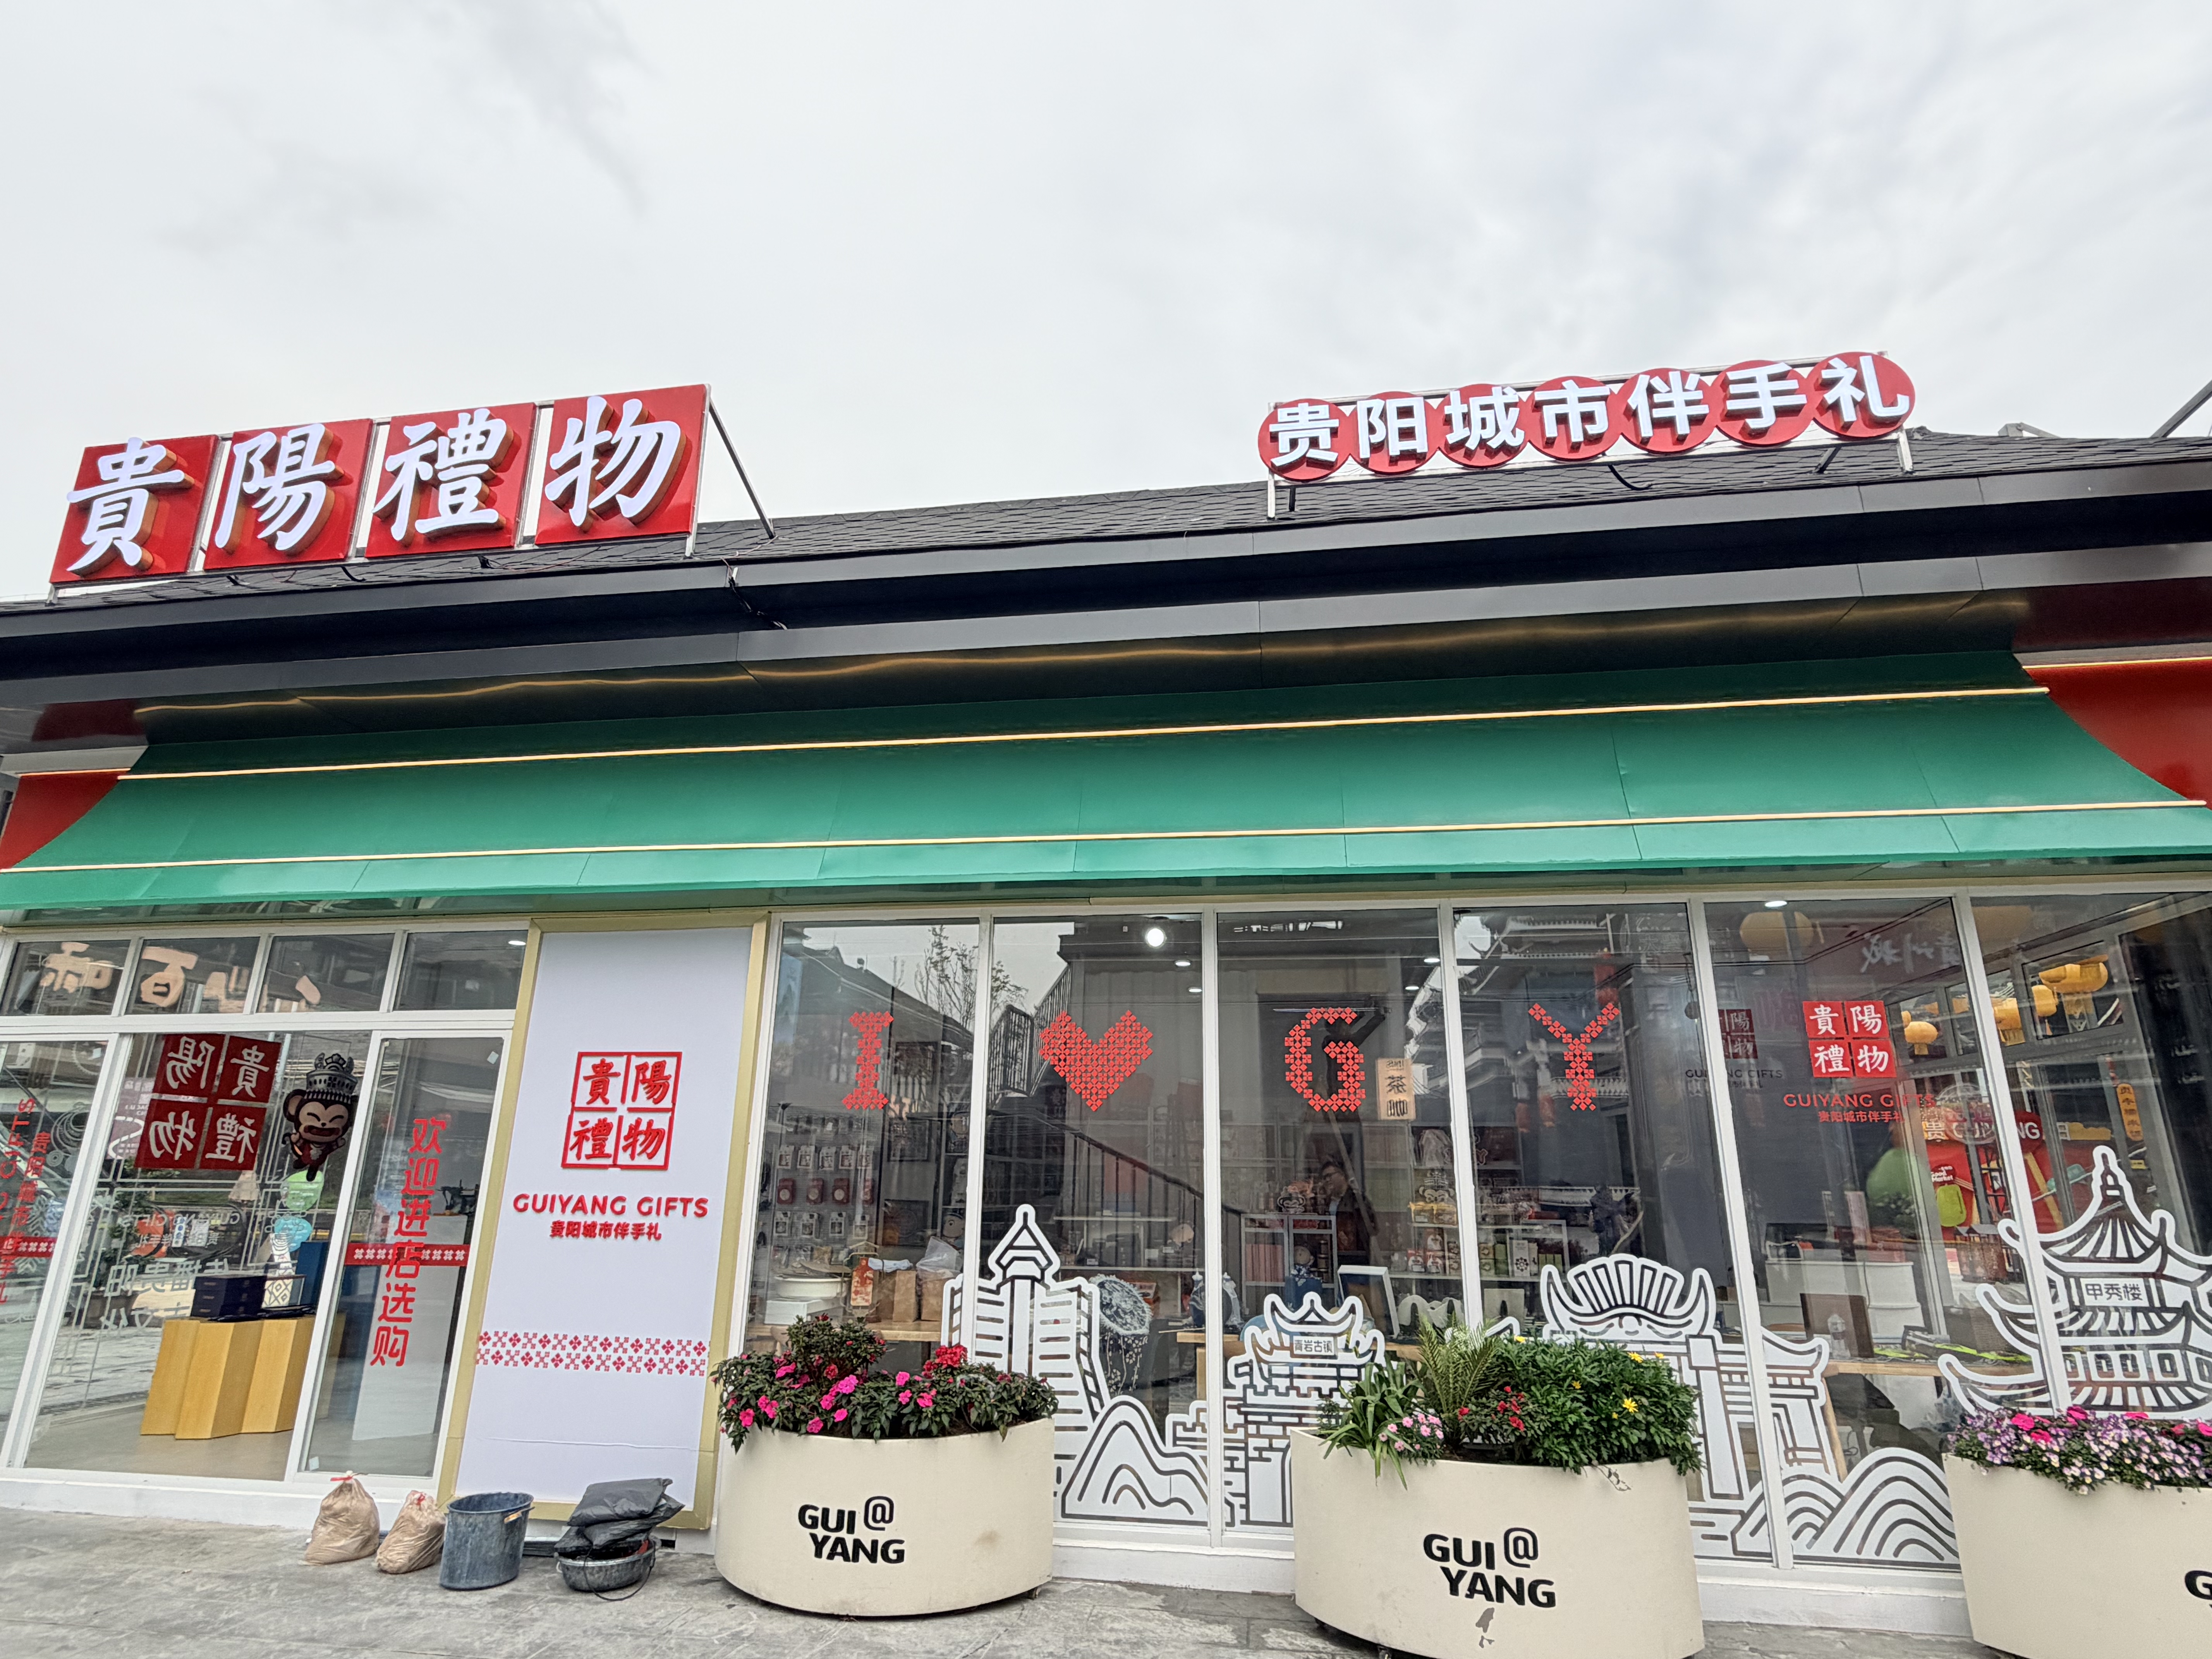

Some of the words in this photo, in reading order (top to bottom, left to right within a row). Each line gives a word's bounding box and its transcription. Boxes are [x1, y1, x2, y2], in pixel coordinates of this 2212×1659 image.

[1269, 353, 1910, 466] 贵阳城市伴手礼
[66, 395, 684, 576] 貴陽禮物
[1719, 1012, 1750, 1031] 陽
[1809, 1004, 1884, 1035] 貴陽
[1814, 1044, 1889, 1073] 禮物
[582, 1058, 672, 1105] 貴陽
[1783, 1094, 1874, 1108] GUIYANG
[1881, 1094, 1937, 1108] GIFTS
[1818, 1110, 1905, 1123] 贵阳城市伴手礼
[569, 1117, 665, 1161] 禮物
[513, 1194, 627, 1216] GUIYANG
[637, 1197, 709, 1218] GIFTS
[370, 1117, 447, 1367] 欢迎进店选购
[549, 1220, 662, 1241] 贵阳城市伴手礼
[2084, 1282, 2143, 1301] 甲秀楼
[1294, 1339, 1333, 1353] 青岩古镇
[798, 1504, 856, 1534] GUI
[809, 1532, 905, 1564] YANG
[1423, 1534, 1496, 1570] GUI
[1439, 1565, 1556, 1608] YANG
